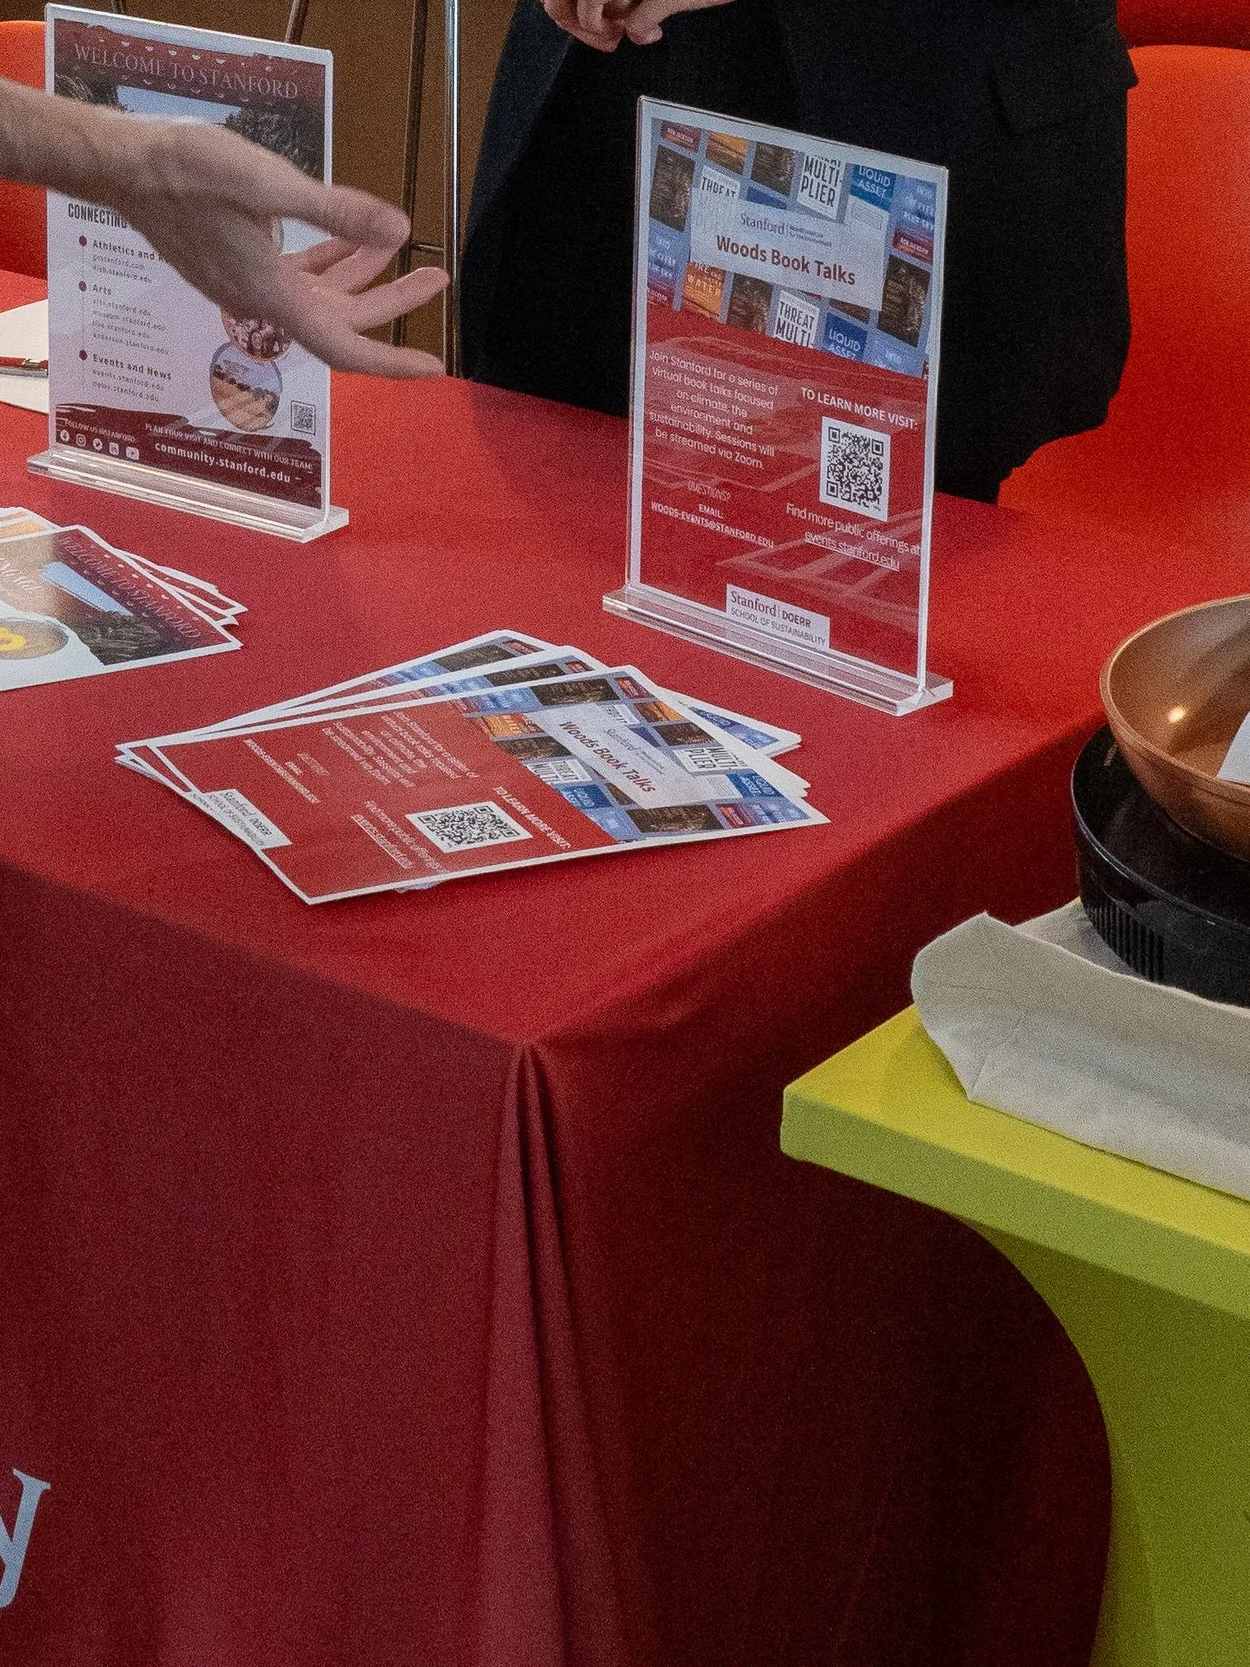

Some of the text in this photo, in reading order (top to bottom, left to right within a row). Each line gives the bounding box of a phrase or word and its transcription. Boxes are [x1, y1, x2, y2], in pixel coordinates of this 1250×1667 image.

[74, 42, 298, 101] WELCOME TO STANFORD
[803, 154, 843, 189] MULTI-
[856, 178, 887, 198] ASSET
[858, 164, 891, 188] LIQUID
[800, 174, 836, 207] PLIER
[739, 211, 785, 236] Stanford
[92, 238, 135, 256] Athletics
[138, 248, 155, 261] and
[715, 232, 767, 263] Woods
[770, 246, 810, 275] Book
[813, 257, 856, 287] Talks
[92, 283, 111, 295] Arts
[686, 273, 722, 297] WATER
[778, 300, 815, 331] THREAT
[828, 327, 861, 352] LIQUID
[92, 353, 172, 380] Events and News
[649, 349, 668, 364] Join
[669, 354, 711, 377] Stanford
[712, 367, 726, 381] for
[736, 375, 767, 393] series
[767, 383, 779, 397] of
[651, 364, 774, 411] virtual book talks focused
[675, 388, 689, 401] on
[731, 403, 748, 419] the
[670, 401, 753, 436] environment and
[800, 385, 918, 432] TO LEARN MORE VISIT:
[218, 441, 252, 456] CONNECT
[655, 426, 667, 440] be
[669, 430, 716, 455] streamed
[717, 446, 733, 461] via
[714, 429, 757, 452] Sessions
[758, 442, 775, 458] will
[154, 440, 291, 484] community.stanford.edu
[785, 501, 807, 521] Find
[807, 510, 834, 529] more
[833, 516, 865, 542] public
[866, 527, 909, 556] offerings
[803, 526, 901, 573] events.stanford.edu
[111, 577, 138, 591] TO
[130, 590, 200, 637] STANFORD
[729, 588, 812, 629] Stanford DOERR
[730, 605, 826, 648] SCHOOL OF SUSTAINABILITY
[560, 722, 599, 747] Woods
[594, 748, 628, 769] Book
[622, 769, 658, 791] Talks
[687, 749, 717, 771] PLIER
[491, 785, 509, 795] TO
[503, 795, 531, 814] LEARN
[525, 814, 552, 831] MORE
